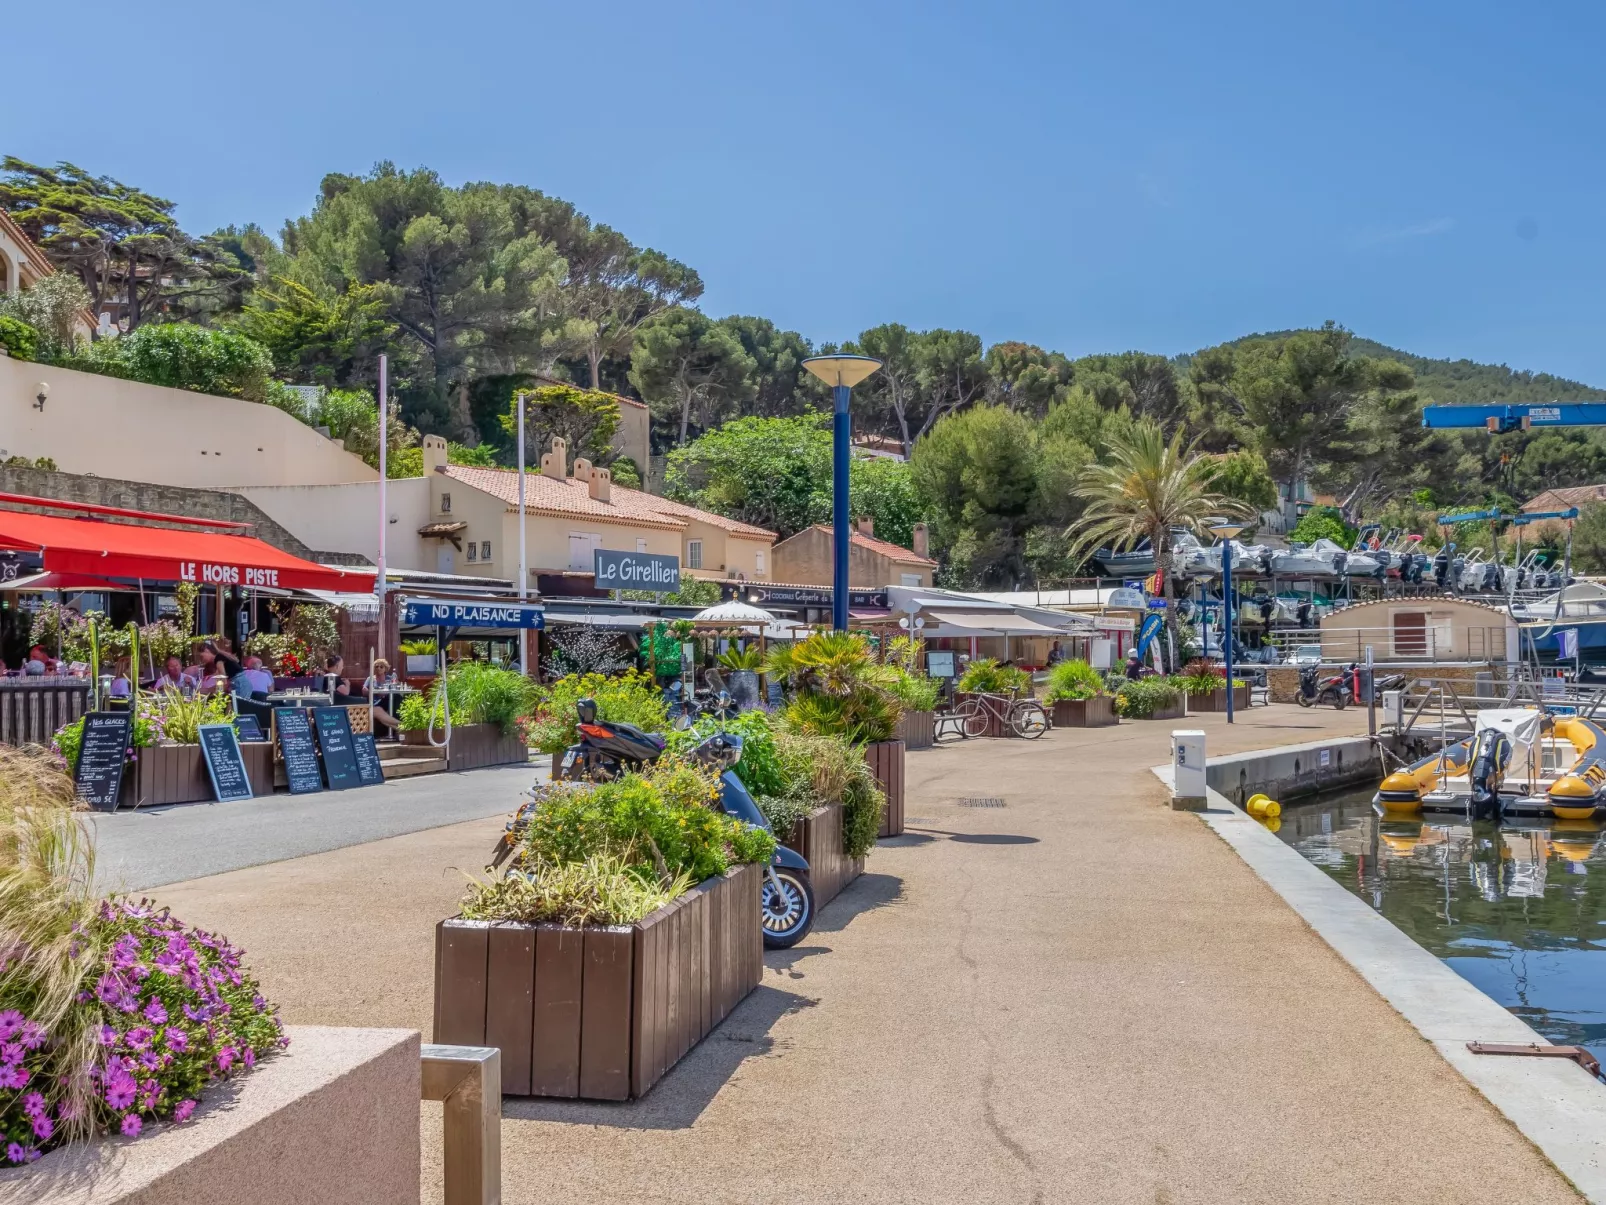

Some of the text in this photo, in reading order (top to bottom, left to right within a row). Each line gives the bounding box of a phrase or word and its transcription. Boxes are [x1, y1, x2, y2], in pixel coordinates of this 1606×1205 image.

[180, 562, 279, 586] LE HORS PISTE
[598, 556, 678, 583] Le Girellier
[432, 604, 521, 622] ND PLAISANCE
